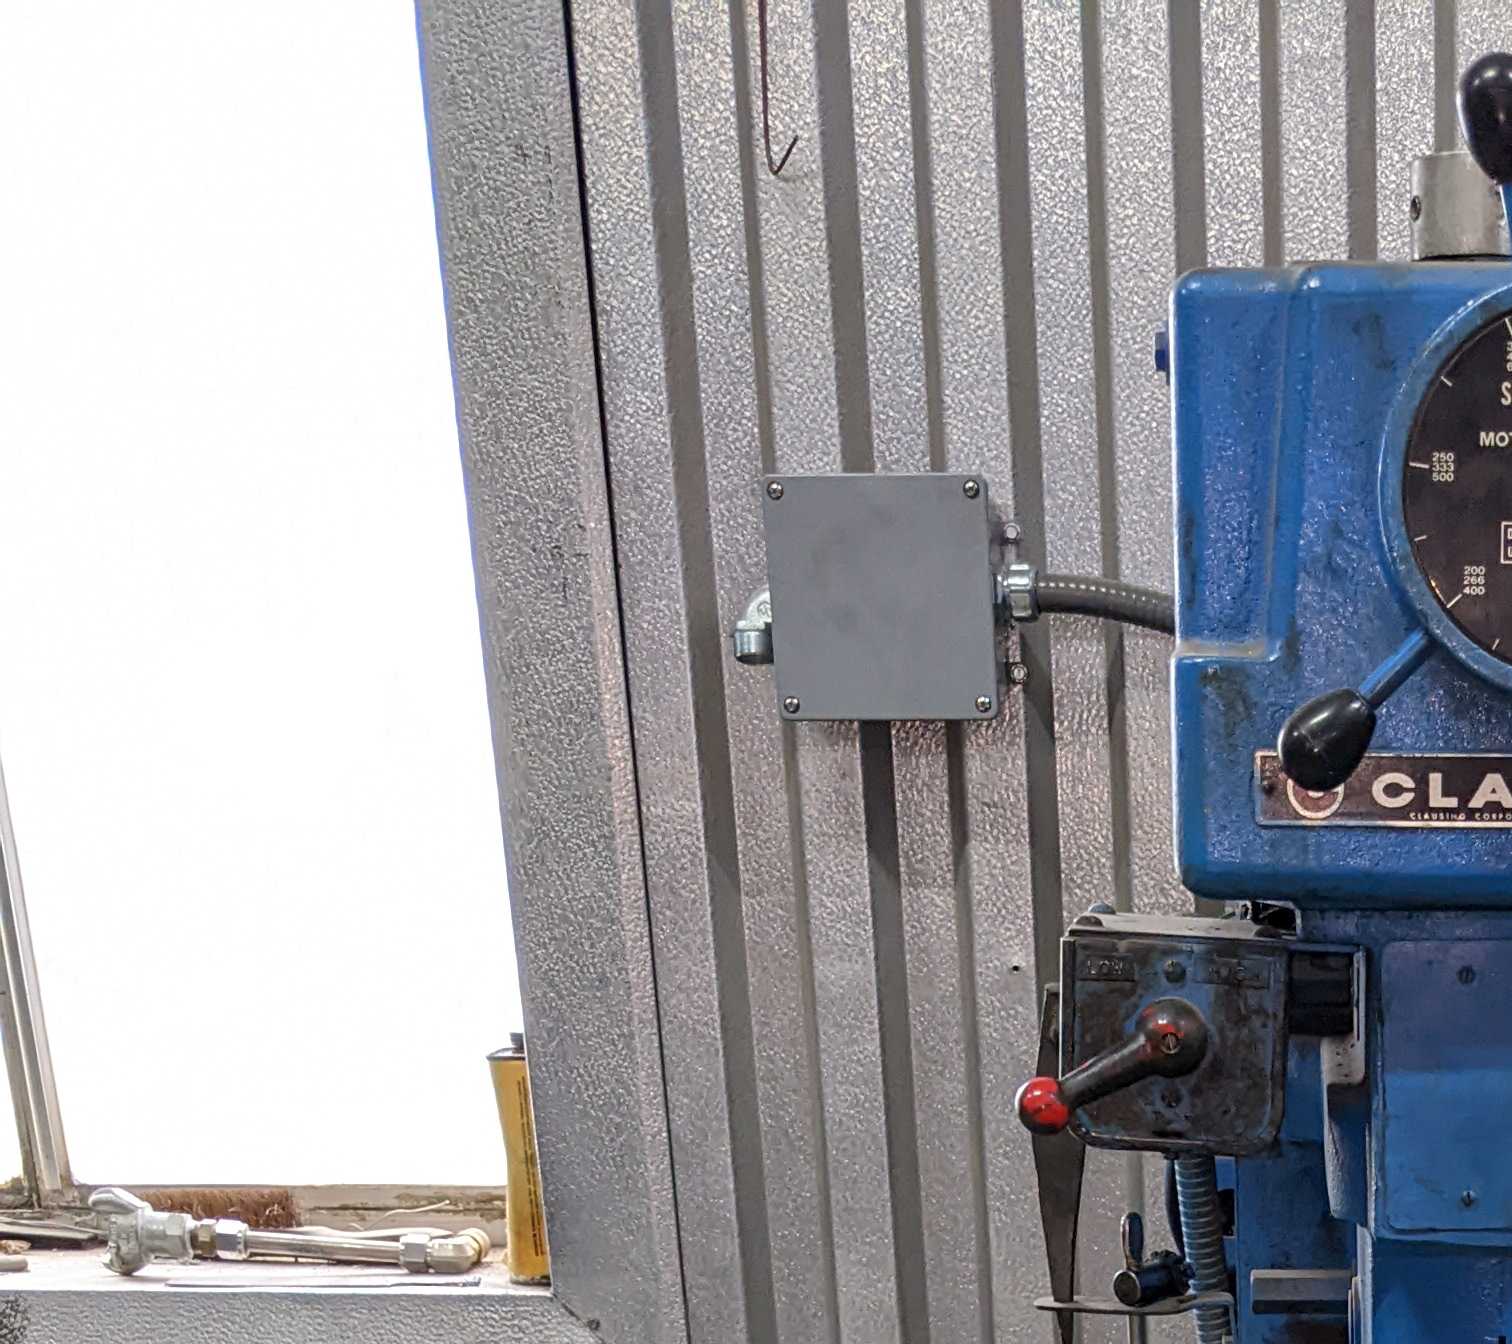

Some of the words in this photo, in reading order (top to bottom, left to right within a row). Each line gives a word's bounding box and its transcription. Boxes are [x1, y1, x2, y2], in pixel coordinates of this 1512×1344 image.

[1432, 452, 1455, 462] 250
[1432, 462, 1455, 472] 333
[1432, 472, 1455, 482] 500
[1464, 566, 1485, 576] 200
[1463, 575, 1485, 585] 266
[1463, 585, 1485, 595] 400
[1409, 812, 1466, 821] CLAUSING
